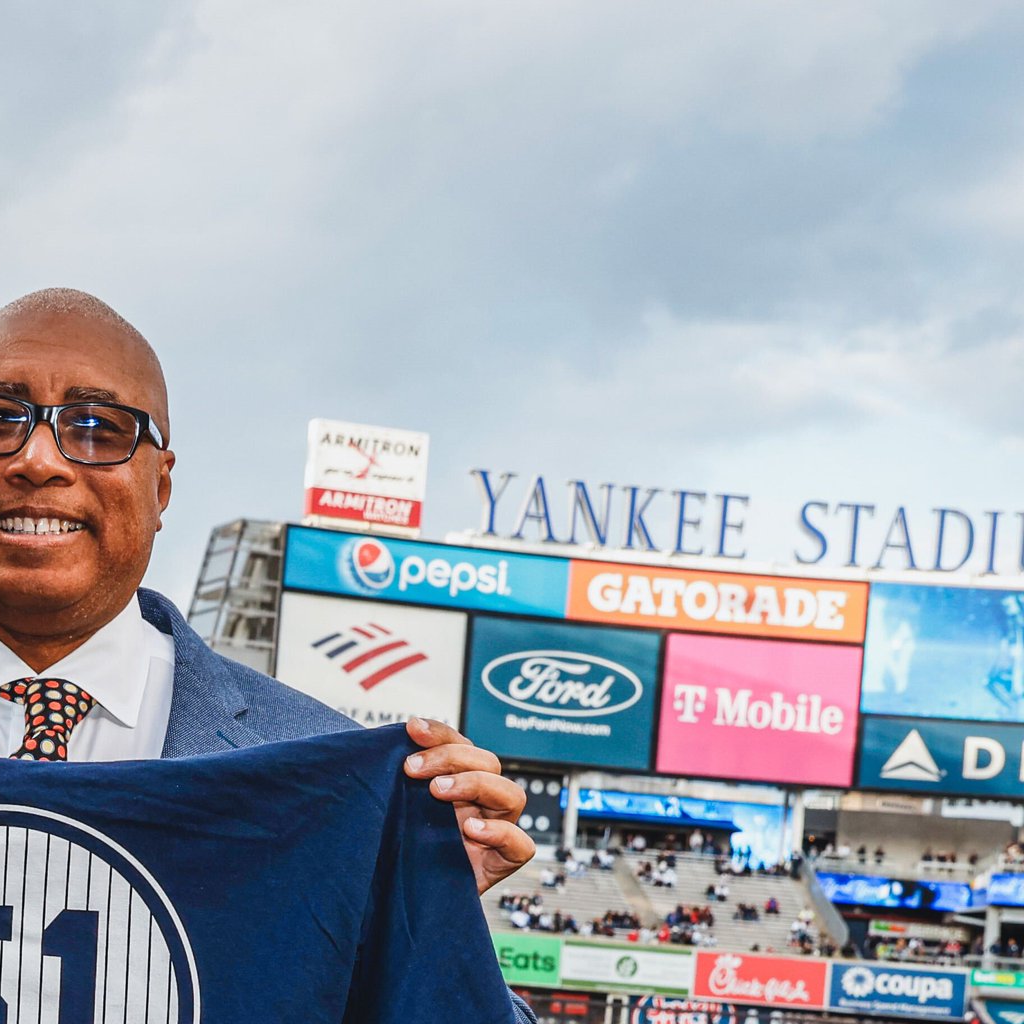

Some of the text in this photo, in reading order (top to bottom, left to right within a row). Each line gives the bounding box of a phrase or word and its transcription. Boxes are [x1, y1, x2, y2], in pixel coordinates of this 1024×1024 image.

[321, 433, 419, 457] ARMITRON
[319, 490, 413, 516] ARMITRON
[470, 468, 750, 559] YANKEE
[398, 555, 508, 597] pepsi
[586, 573, 847, 631] GATORADE
[508, 656, 615, 709] Ford
[505, 714, 611, 737] BuyFordNow.com
[674, 684, 844, 735] T Mobile
[499, 947, 556, 973] Eats
[875, 972, 953, 1003] coupa
